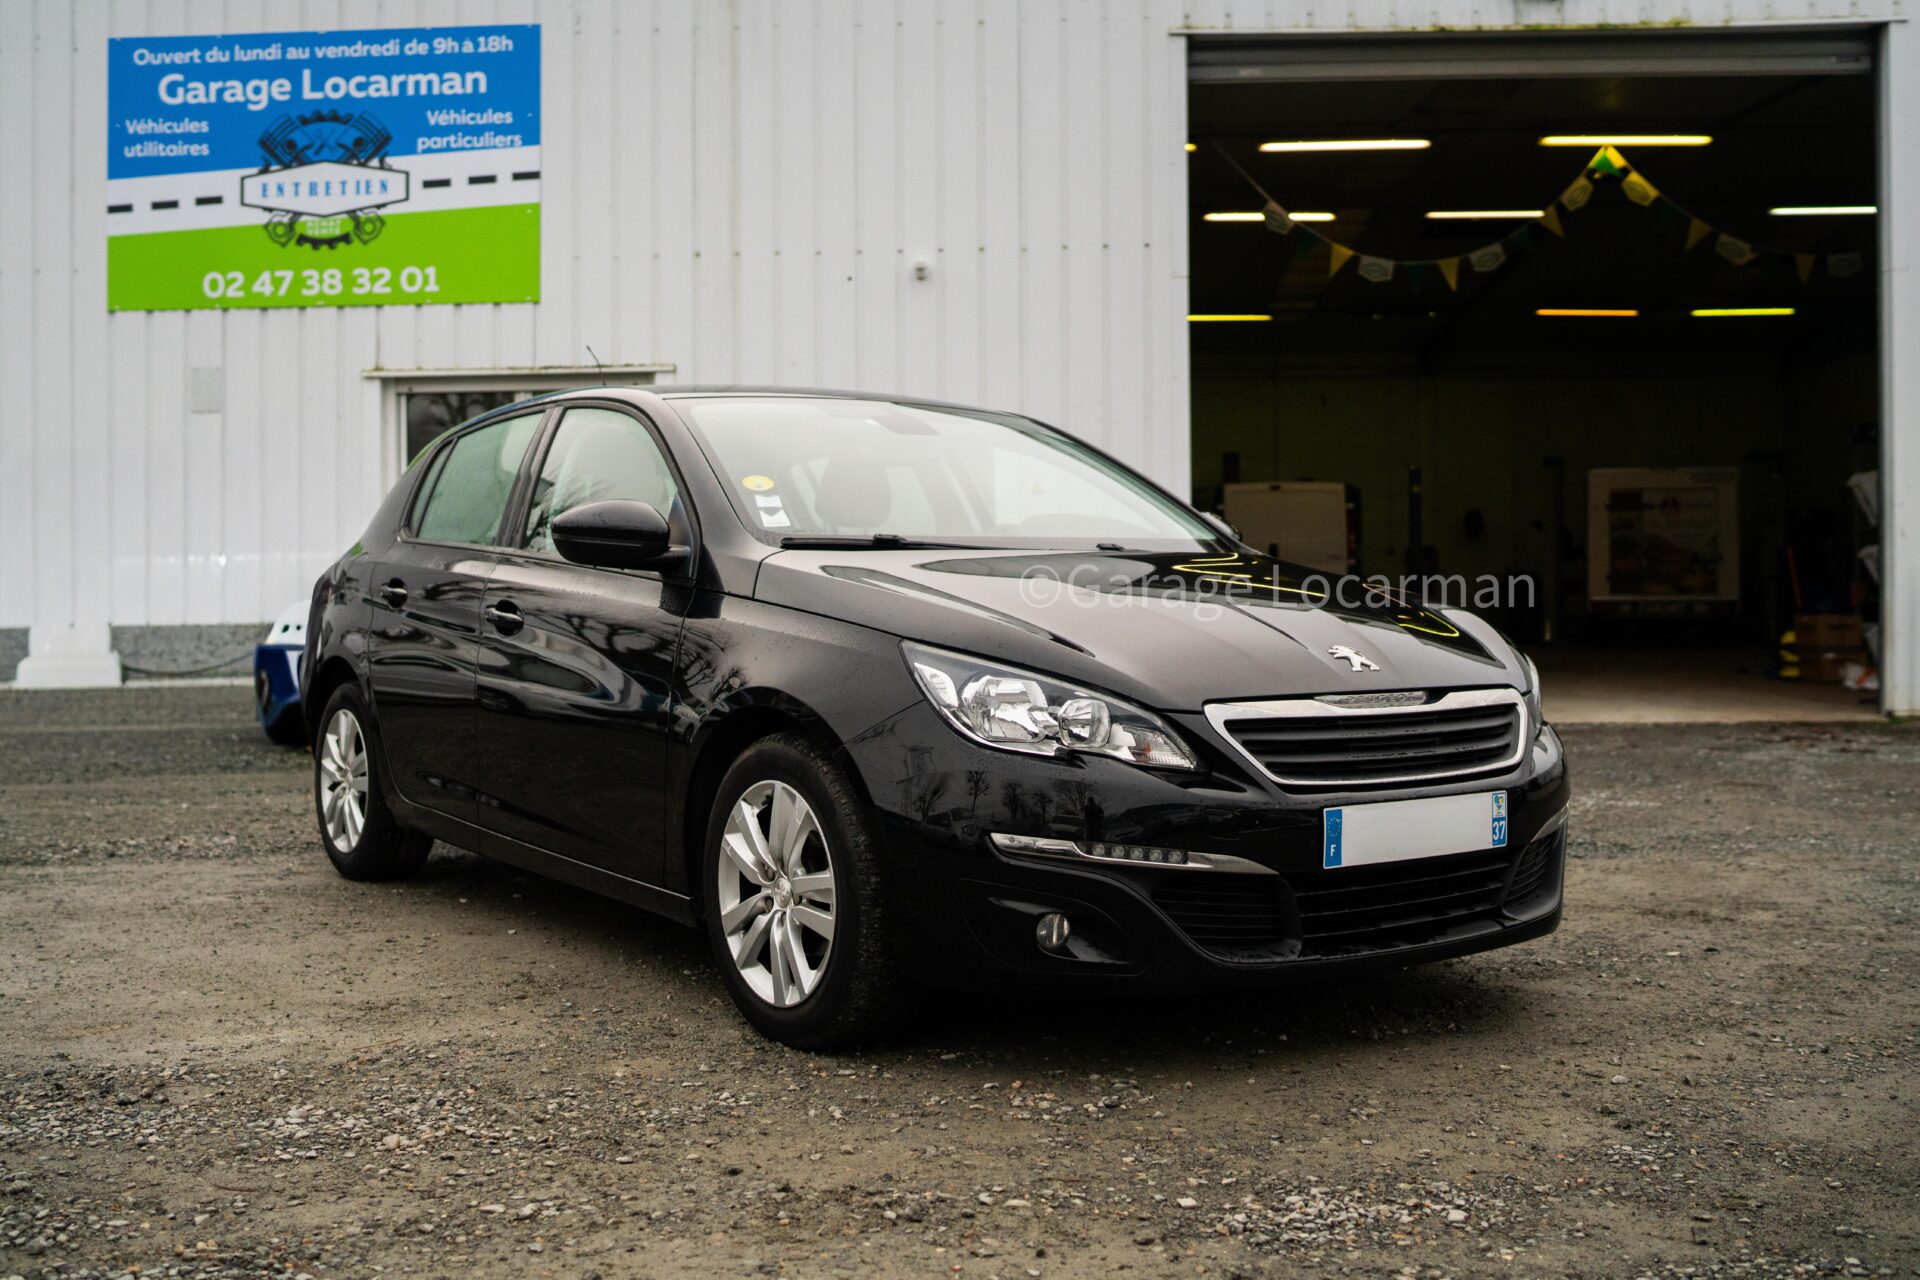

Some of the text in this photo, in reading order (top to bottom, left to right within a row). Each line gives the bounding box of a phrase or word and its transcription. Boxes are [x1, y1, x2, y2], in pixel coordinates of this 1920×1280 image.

[133, 48, 201, 66] Ouvert
[205, 46, 230, 63] du
[234, 43, 282, 62] lundi
[285, 46, 310, 60] au
[314, 39, 400, 58] vendredi
[403, 37, 430, 55] de
[433, 36, 459, 54] 9h
[477, 35, 513, 53] 18h
[158, 68, 488, 111] Garage Locarman
[125, 117, 210, 135] Véhicules
[426, 108, 513, 126] Véhicules
[124, 140, 210, 158] utilitaires
[417, 131, 522, 153] particuliers
[261, 179, 388, 198] ENTRETIEN
[202, 265, 440, 299] 02 47 38 32 01
[1492, 820, 1506, 840] 37
[1330, 844, 1337, 857] F
